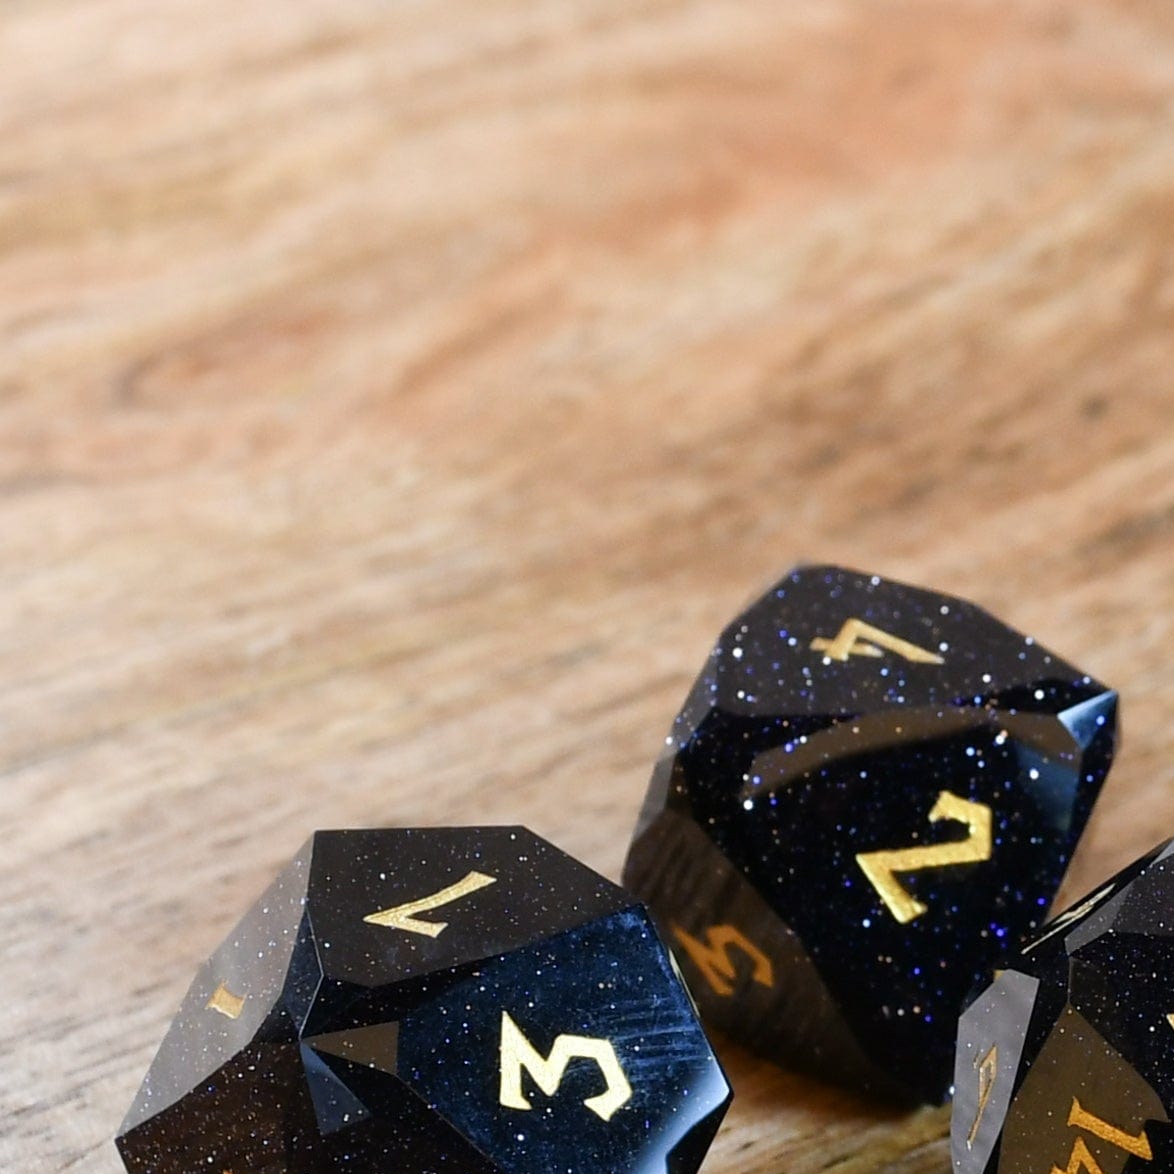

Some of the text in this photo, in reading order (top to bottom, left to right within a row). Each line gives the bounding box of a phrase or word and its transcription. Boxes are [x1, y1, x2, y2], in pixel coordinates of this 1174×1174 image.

[809, 616, 946, 665] 4
[856, 789, 993, 925] 2
[498, 1010, 633, 1122] 3
